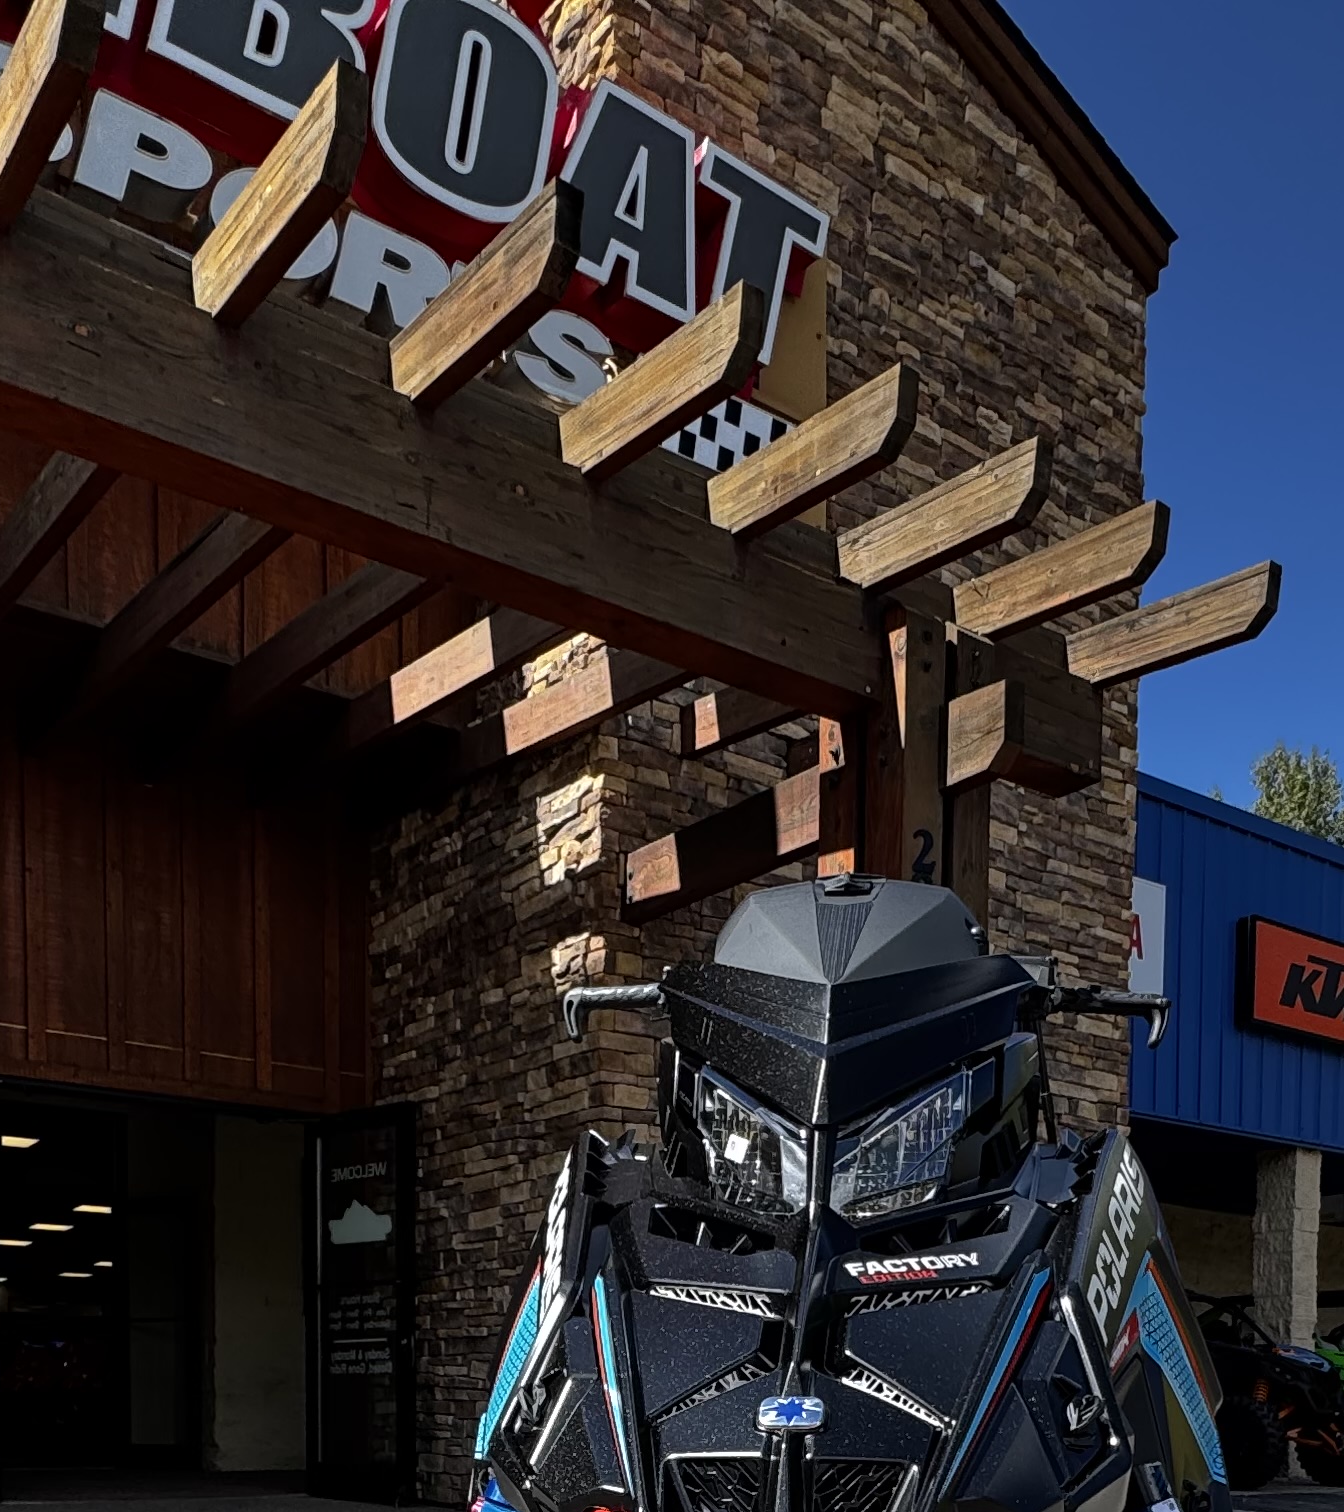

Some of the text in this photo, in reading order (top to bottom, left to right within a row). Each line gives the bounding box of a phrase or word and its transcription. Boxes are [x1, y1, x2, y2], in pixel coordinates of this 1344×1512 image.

[1087, 1142, 1145, 1346] POLARIS
[844, 1252, 980, 1277] FACTORY
[857, 1270, 939, 1285] EDITION
